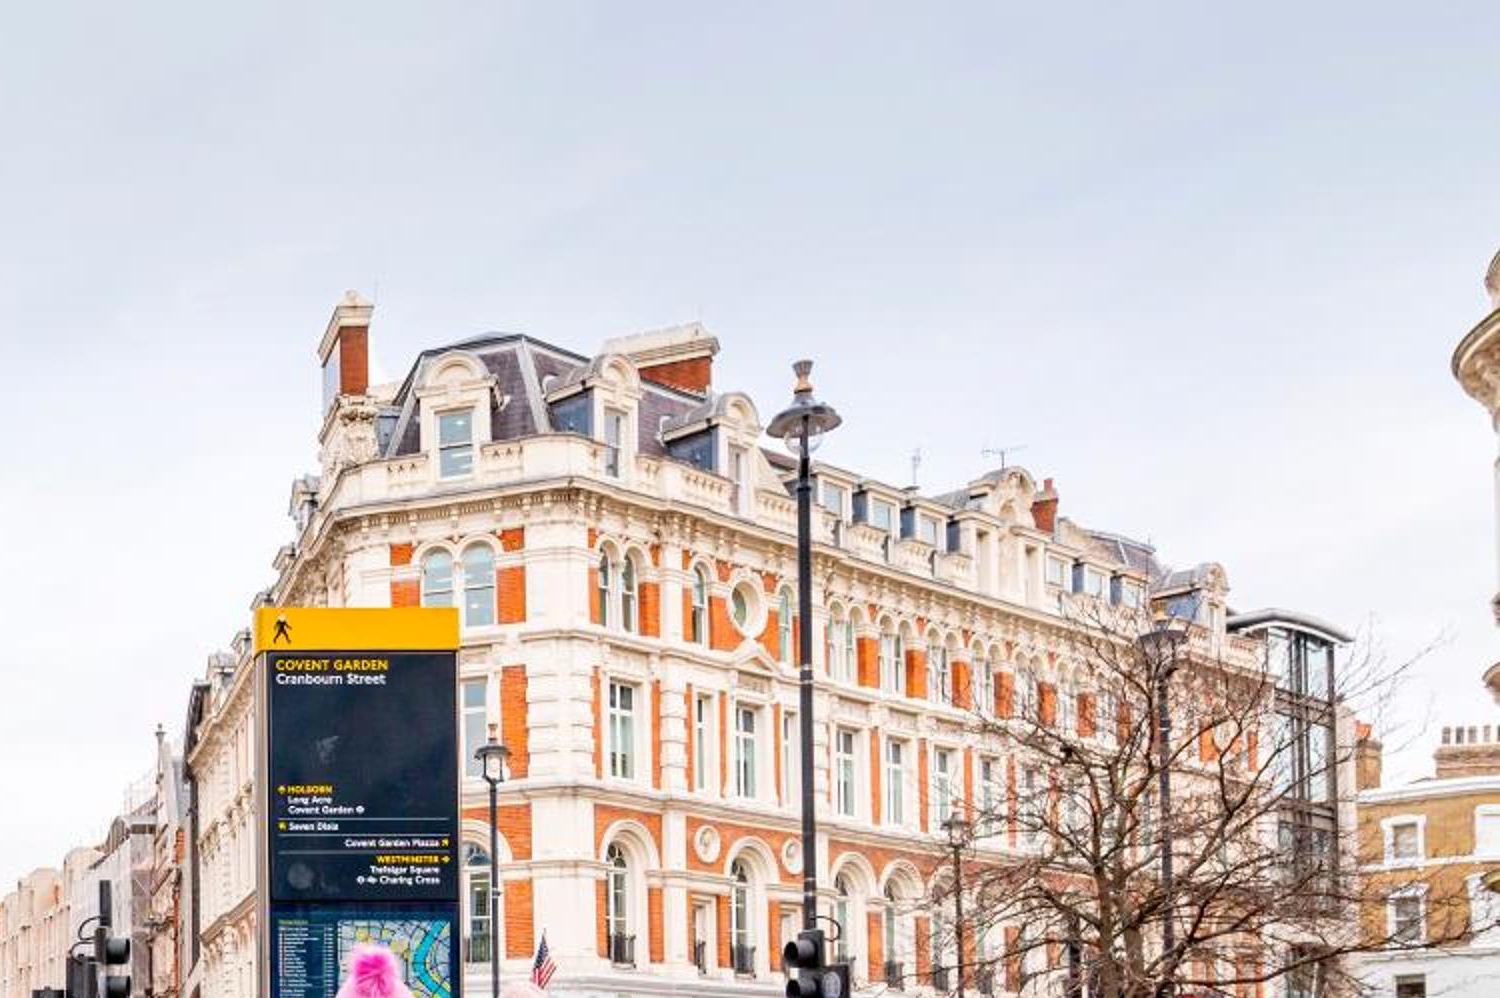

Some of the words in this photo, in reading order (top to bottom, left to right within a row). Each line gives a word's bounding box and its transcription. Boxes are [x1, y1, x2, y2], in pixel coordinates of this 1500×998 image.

[276, 659, 330, 671] COVENT
[334, 659, 388, 671] GARDEN
[276, 673, 343, 685] Cranbourn
[347, 673, 386, 685] Street
[287, 786, 333, 794] HOLBORN
[287, 796, 309, 805] Long
[312, 796, 332, 804] Acre
[287, 806, 320, 815] Covent
[321, 806, 354, 815] Garden
[288, 822, 315, 831] Seven
[317, 822, 339, 831] Dials
[344, 839, 376, 848] Covent
[378, 839, 411, 848] Garden
[412, 839, 440, 848] Piazza
[377, 855, 440, 864] WESTMINSTER
[370, 866, 406, 875] Trafalgar
[409, 866, 440, 875] Square
[380, 876, 413, 886] Charing
[415, 876, 440, 885] Cross
